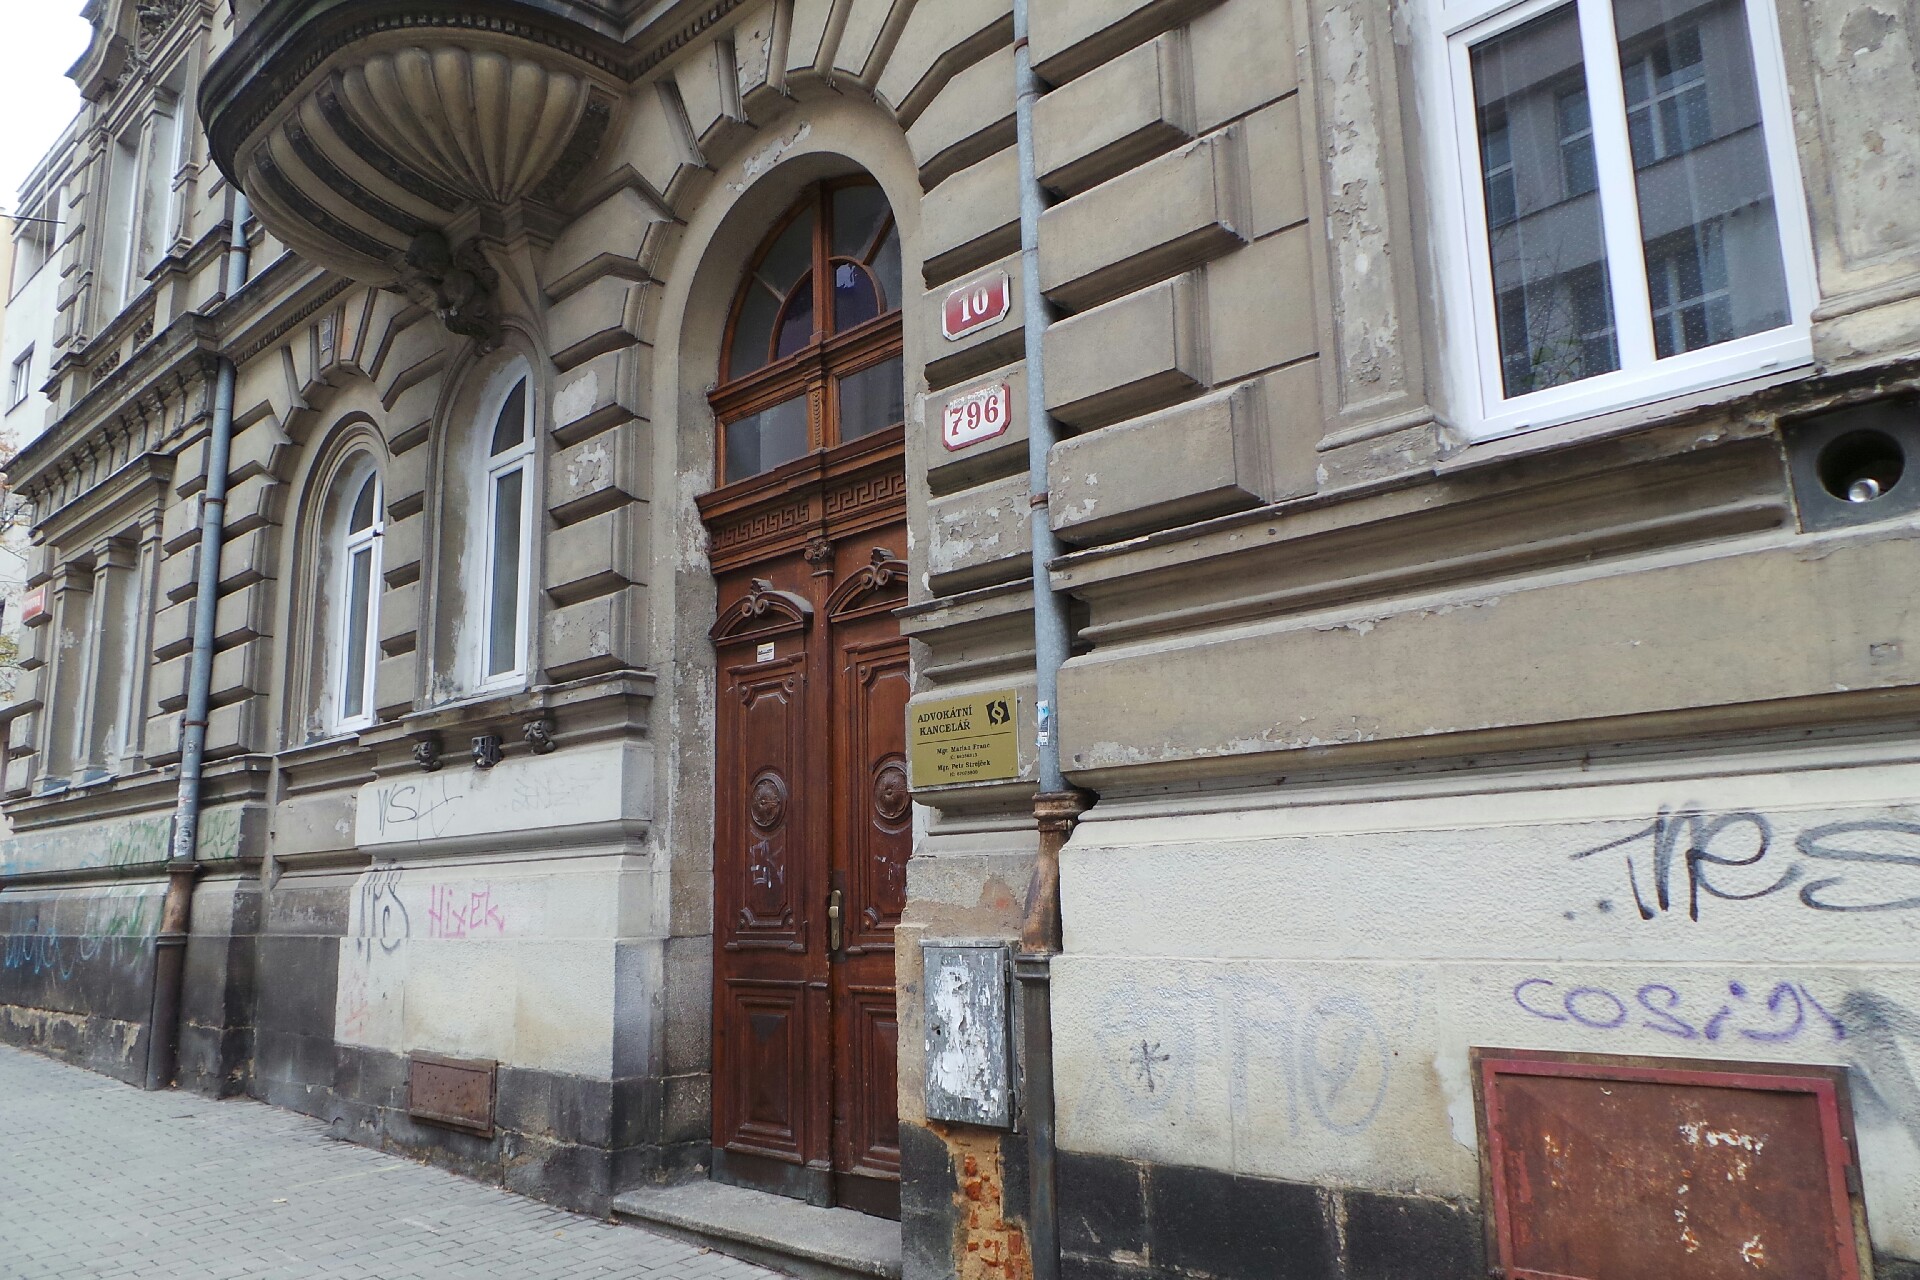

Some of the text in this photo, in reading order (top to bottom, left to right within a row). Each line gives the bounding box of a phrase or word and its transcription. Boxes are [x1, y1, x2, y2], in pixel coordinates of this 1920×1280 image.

[959, 286, 989, 323] 10
[949, 394, 999, 436] 796
[918, 704, 973, 724] ADVOKÁTNÍ
[919, 718, 971, 736] KANCELÁŘ
